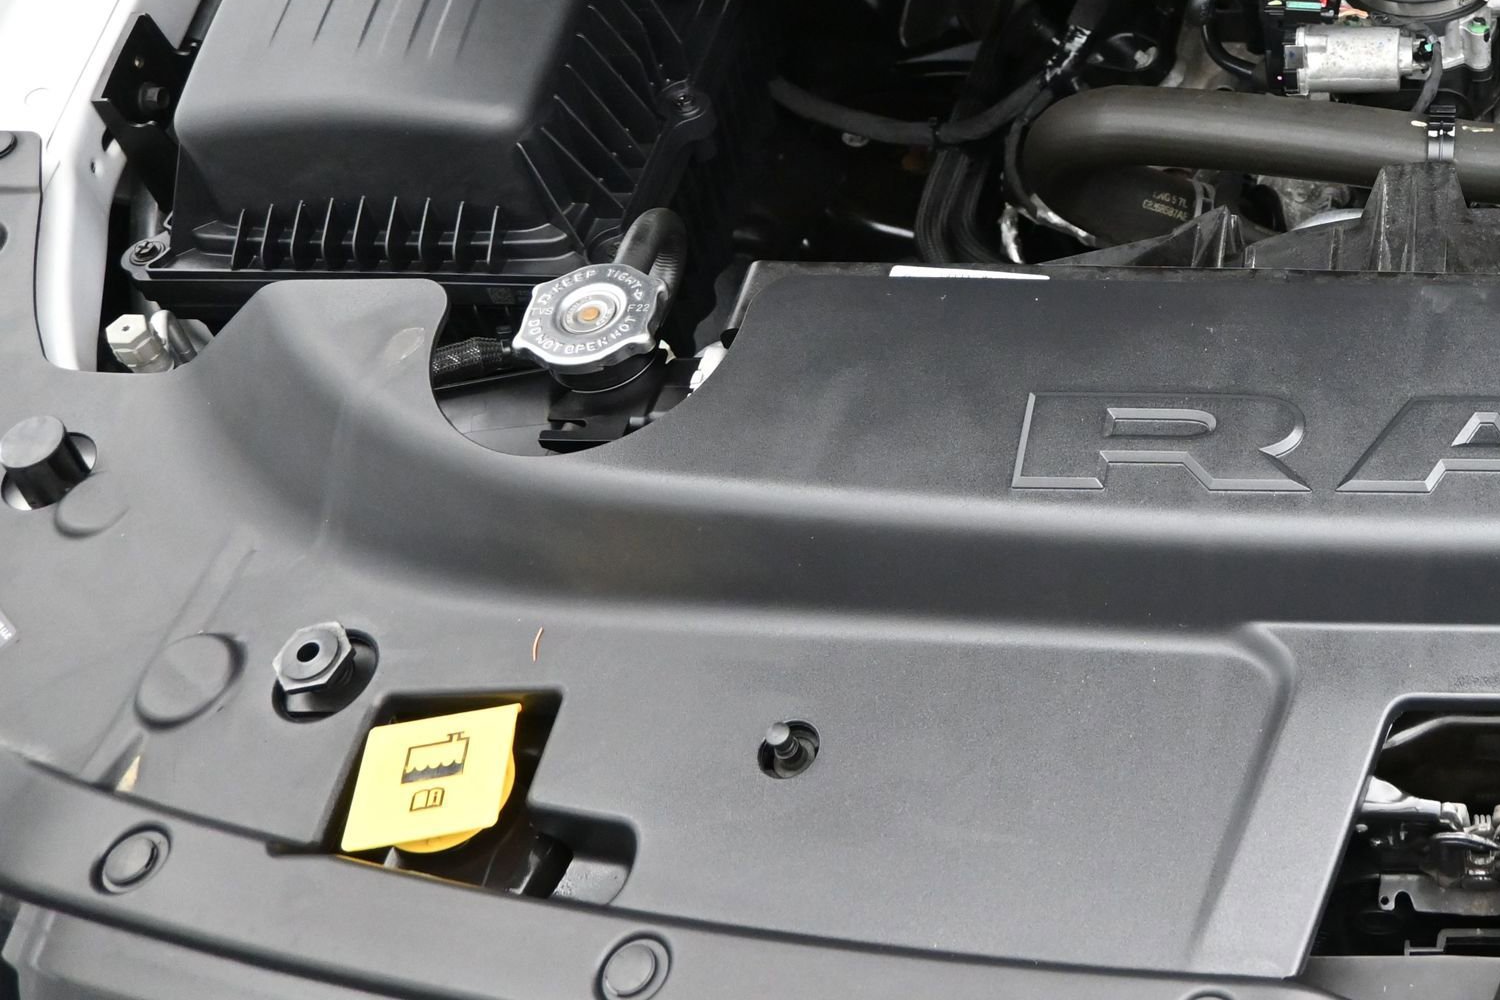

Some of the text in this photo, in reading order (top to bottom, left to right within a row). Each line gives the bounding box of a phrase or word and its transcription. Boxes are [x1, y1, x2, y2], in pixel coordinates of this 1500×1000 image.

[552, 267, 643, 293] KEEP TIGHT
[626, 303, 650, 313] F22
[527, 315, 637, 355] DO NOT OPEN HOT
